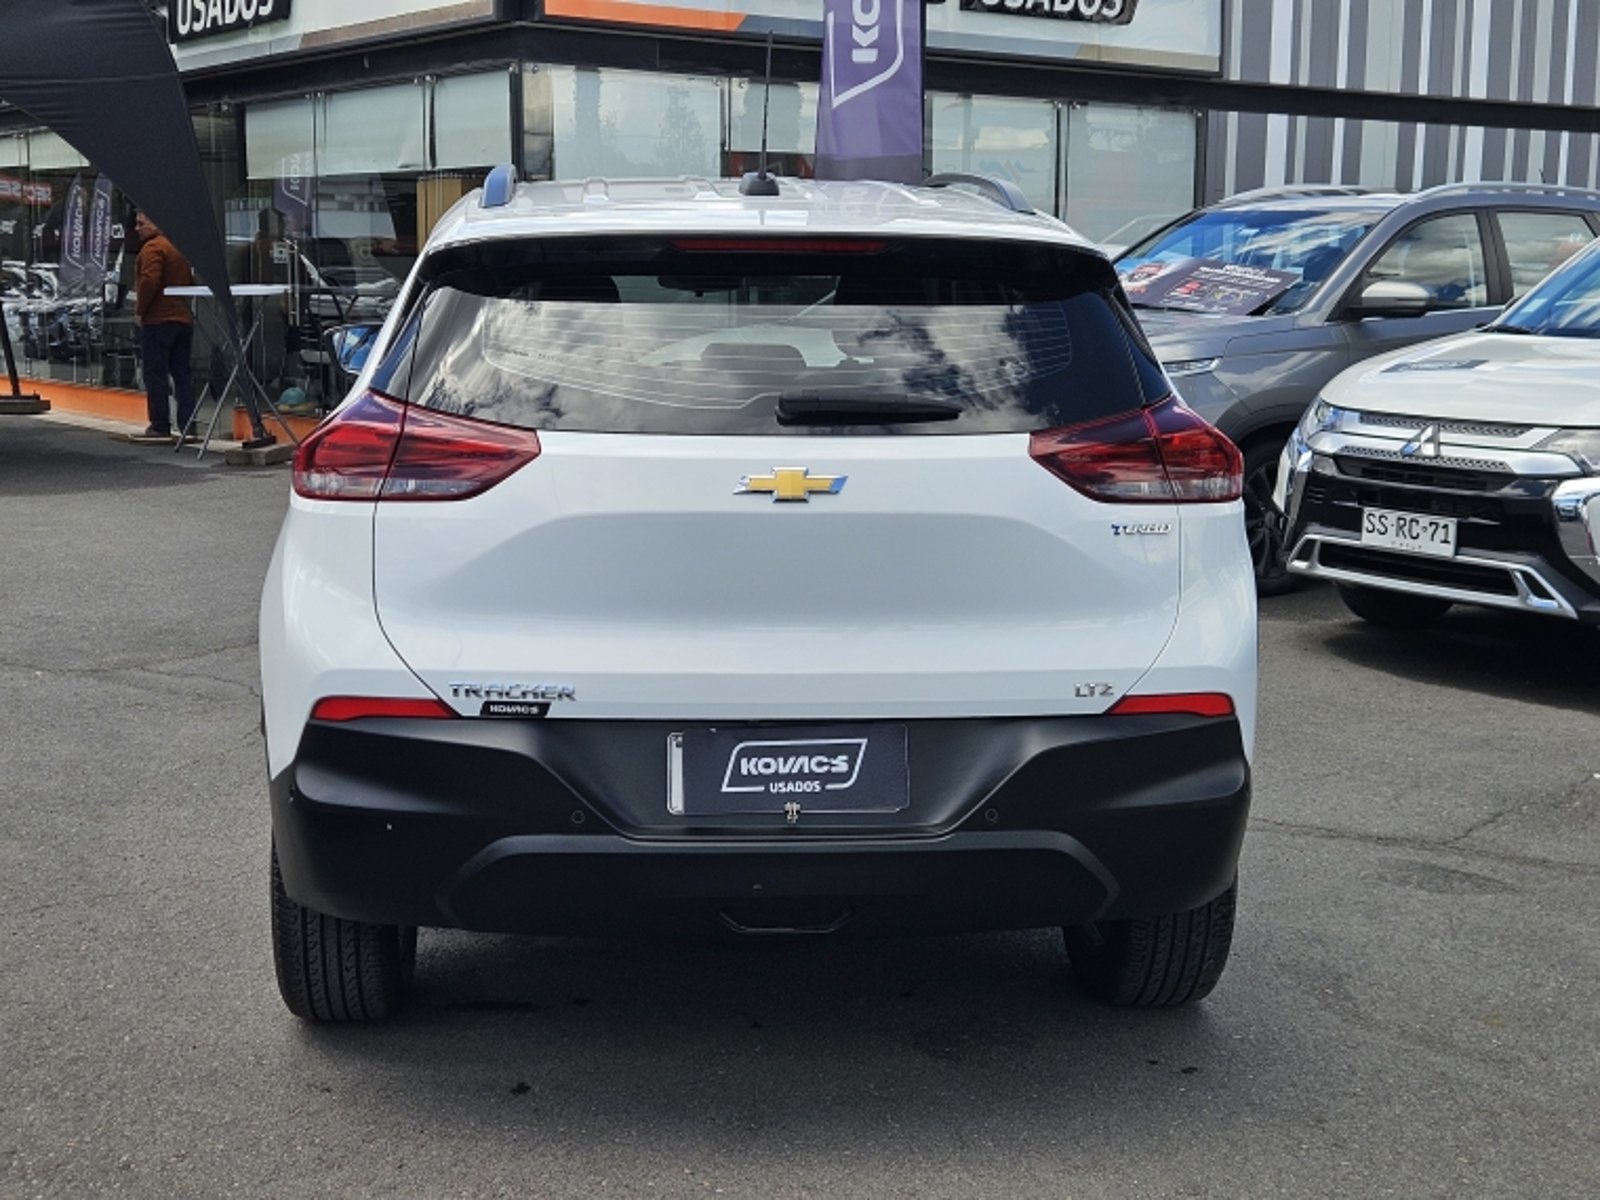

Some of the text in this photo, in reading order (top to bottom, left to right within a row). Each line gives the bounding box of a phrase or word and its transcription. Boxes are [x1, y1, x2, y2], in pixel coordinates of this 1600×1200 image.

[448, 681, 577, 701] TRACKER
[1073, 682, 1114, 698] LTZ
[489, 704, 539, 715] KOVACS
[740, 755, 849, 775] KOVACS
[769, 780, 821, 794] USADOS
